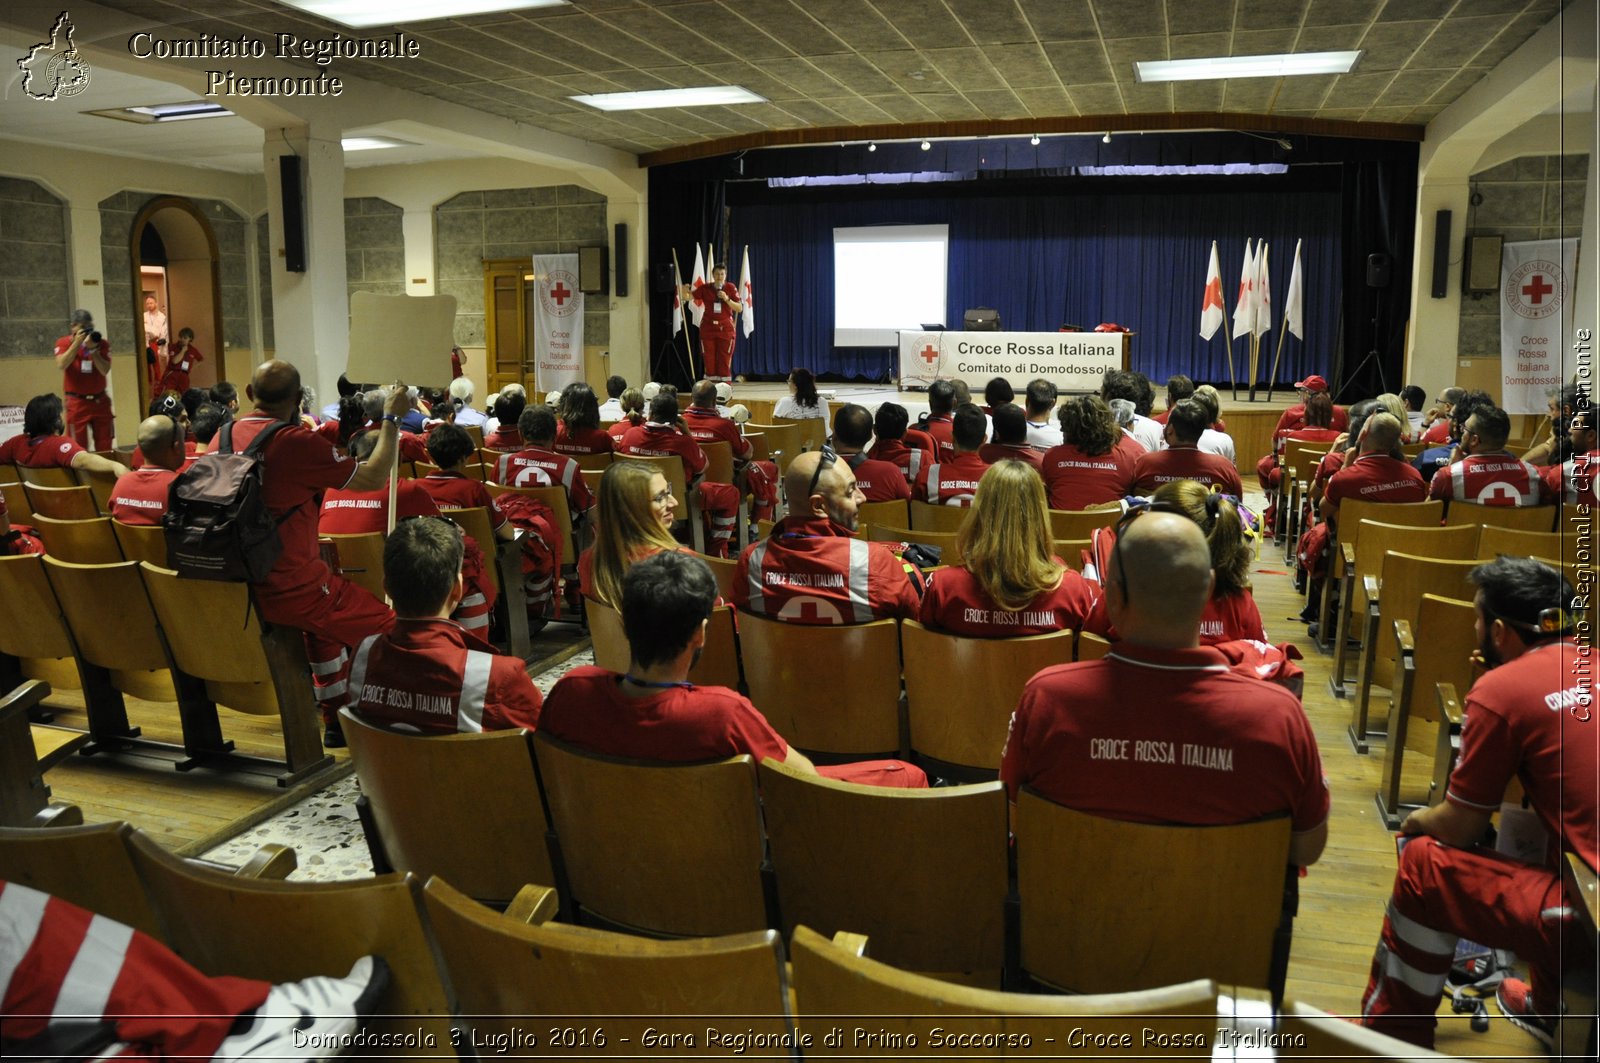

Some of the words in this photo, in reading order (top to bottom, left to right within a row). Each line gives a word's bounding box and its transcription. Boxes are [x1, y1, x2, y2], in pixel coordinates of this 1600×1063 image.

[551, 330, 570, 339] Croce
[550, 340, 570, 349] Rossa
[1520, 335, 1549, 345] Croce
[957, 341, 1002, 356] Croce
[1007, 342, 1054, 356] Rossa
[1059, 342, 1115, 356] Italiana
[549, 351, 572, 360] Italiana
[1518, 349, 1547, 359] Rossa
[957, 362, 1011, 374] Comitato
[1016, 362, 1026, 374] di
[1517, 361, 1550, 372] Italiana
[1505, 375, 1562, 386] Domodossola
[1058, 461, 1075, 469] CROCE
[1075, 461, 1091, 469] ROSSA
[1092, 462, 1117, 471] ITALIANA
[1435, 457, 1450, 467] CRO
[1470, 463, 1485, 473] CROCE
[1486, 463, 1502, 472] ROSSA
[941, 480, 955, 489] CROCE
[956, 480, 970, 489] ROSSA
[1360, 486, 1378, 495] CROCE
[1378, 483, 1395, 491] ROSSA
[1394, 480, 1418, 488] ITALIANA
[325, 500, 338, 509] CROCE
[338, 499, 355, 508] ROSSA
[356, 499, 381, 508] ITALIANA
[766, 571, 787, 585] CROCE
[789, 572, 812, 586] ROSSA
[814, 573, 844, 588] ITALIANA
[964, 607, 989, 624] CROCE
[993, 610, 1020, 626] ROSSA
[1023, 610, 1056, 626] ITALIANA
[1199, 620, 1224, 636] ALIANA
[361, 684, 386, 704] CROCE
[387, 688, 413, 710] ROSSA
[415, 693, 452, 715] ITALIANA
[1090, 738, 1130, 760] CROCE
[1135, 740, 1176, 764] ROSSA
[1182, 743, 1233, 772] ITALIANA
